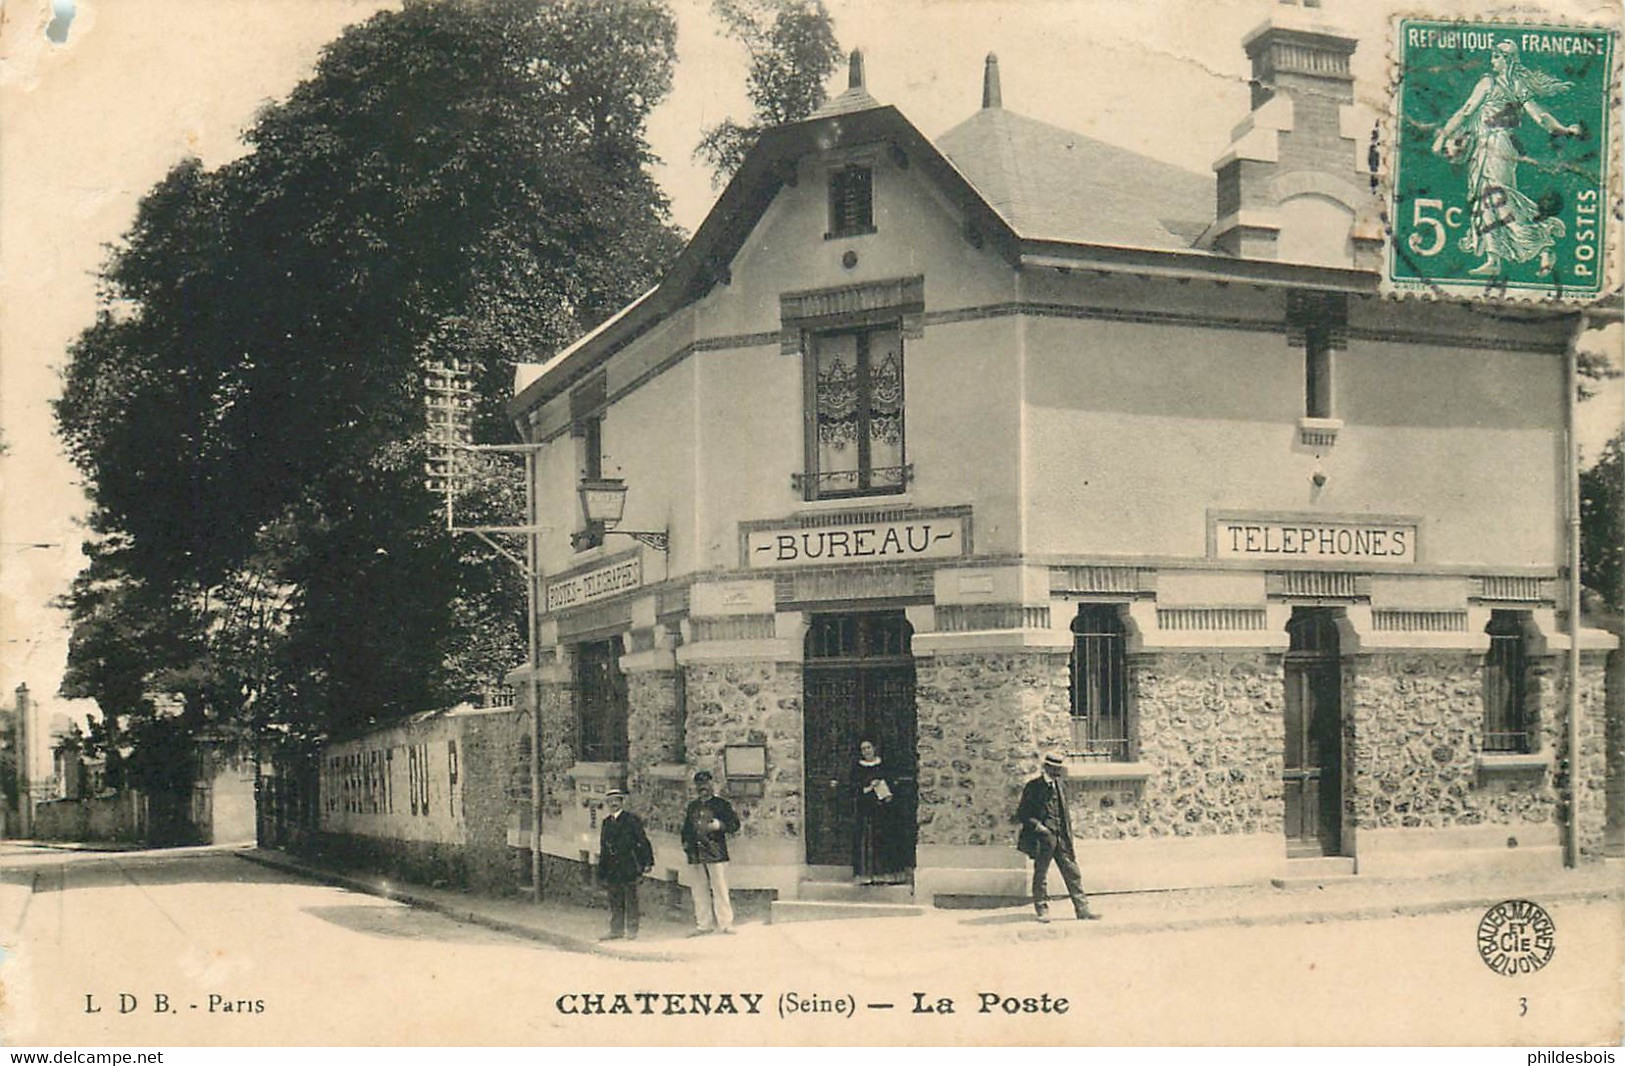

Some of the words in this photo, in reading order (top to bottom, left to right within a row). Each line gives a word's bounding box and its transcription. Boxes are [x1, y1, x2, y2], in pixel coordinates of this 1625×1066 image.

[1408, 28, 1495, 53] REPUBLIQUE
[1521, 34, 1604, 56] FRANÇAISE
[1574, 189, 1597, 276] POSTES
[1228, 526, 1406, 556] TELEPHONES
[408, 744, 430, 817] DU
[1509, 922, 1528, 935] ET
[1490, 952, 1543, 976] DIJON
[85, 994, 102, 1013] L
[119, 994, 137, 1013] D
[208, 994, 265, 1013] Paris
[555, 992, 764, 1015] CHATENAY
[778, 992, 856, 1019] (Seine)
[912, 992, 955, 1014] La
[978, 992, 1070, 1014] Poste
[1518, 997, 1528, 1017] 3
